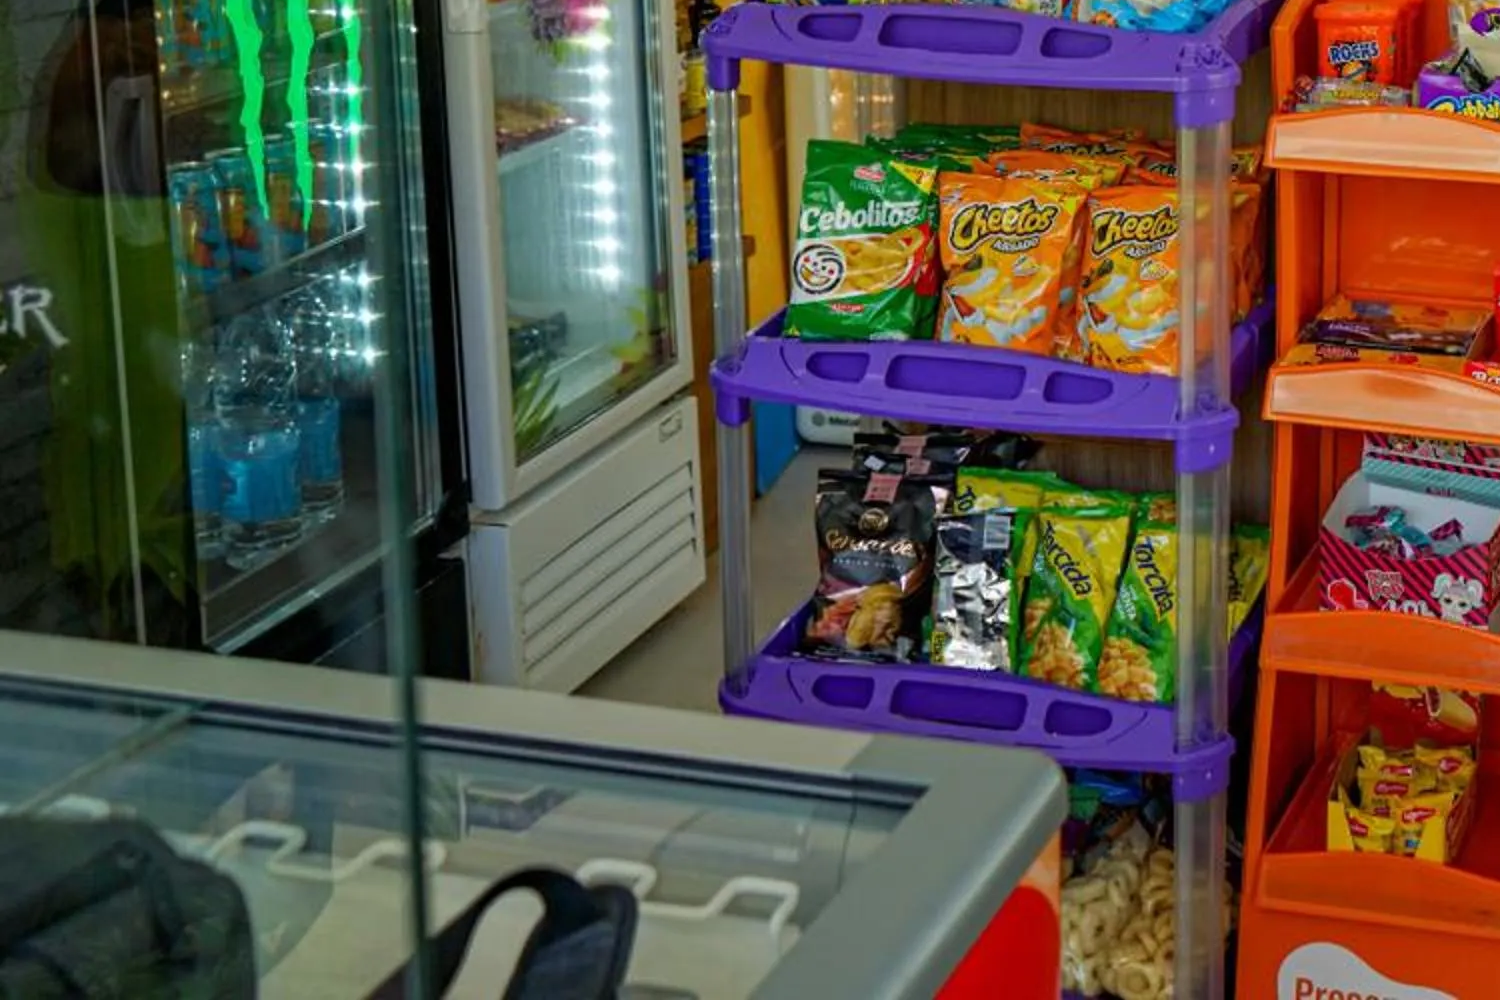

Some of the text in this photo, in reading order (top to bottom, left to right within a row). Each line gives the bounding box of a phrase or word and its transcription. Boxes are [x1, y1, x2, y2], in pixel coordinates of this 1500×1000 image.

[800, 200, 925, 233] Cebolitos
[950, 197, 1060, 253] Cheetos
[1041, 519, 1094, 598] Torcida
